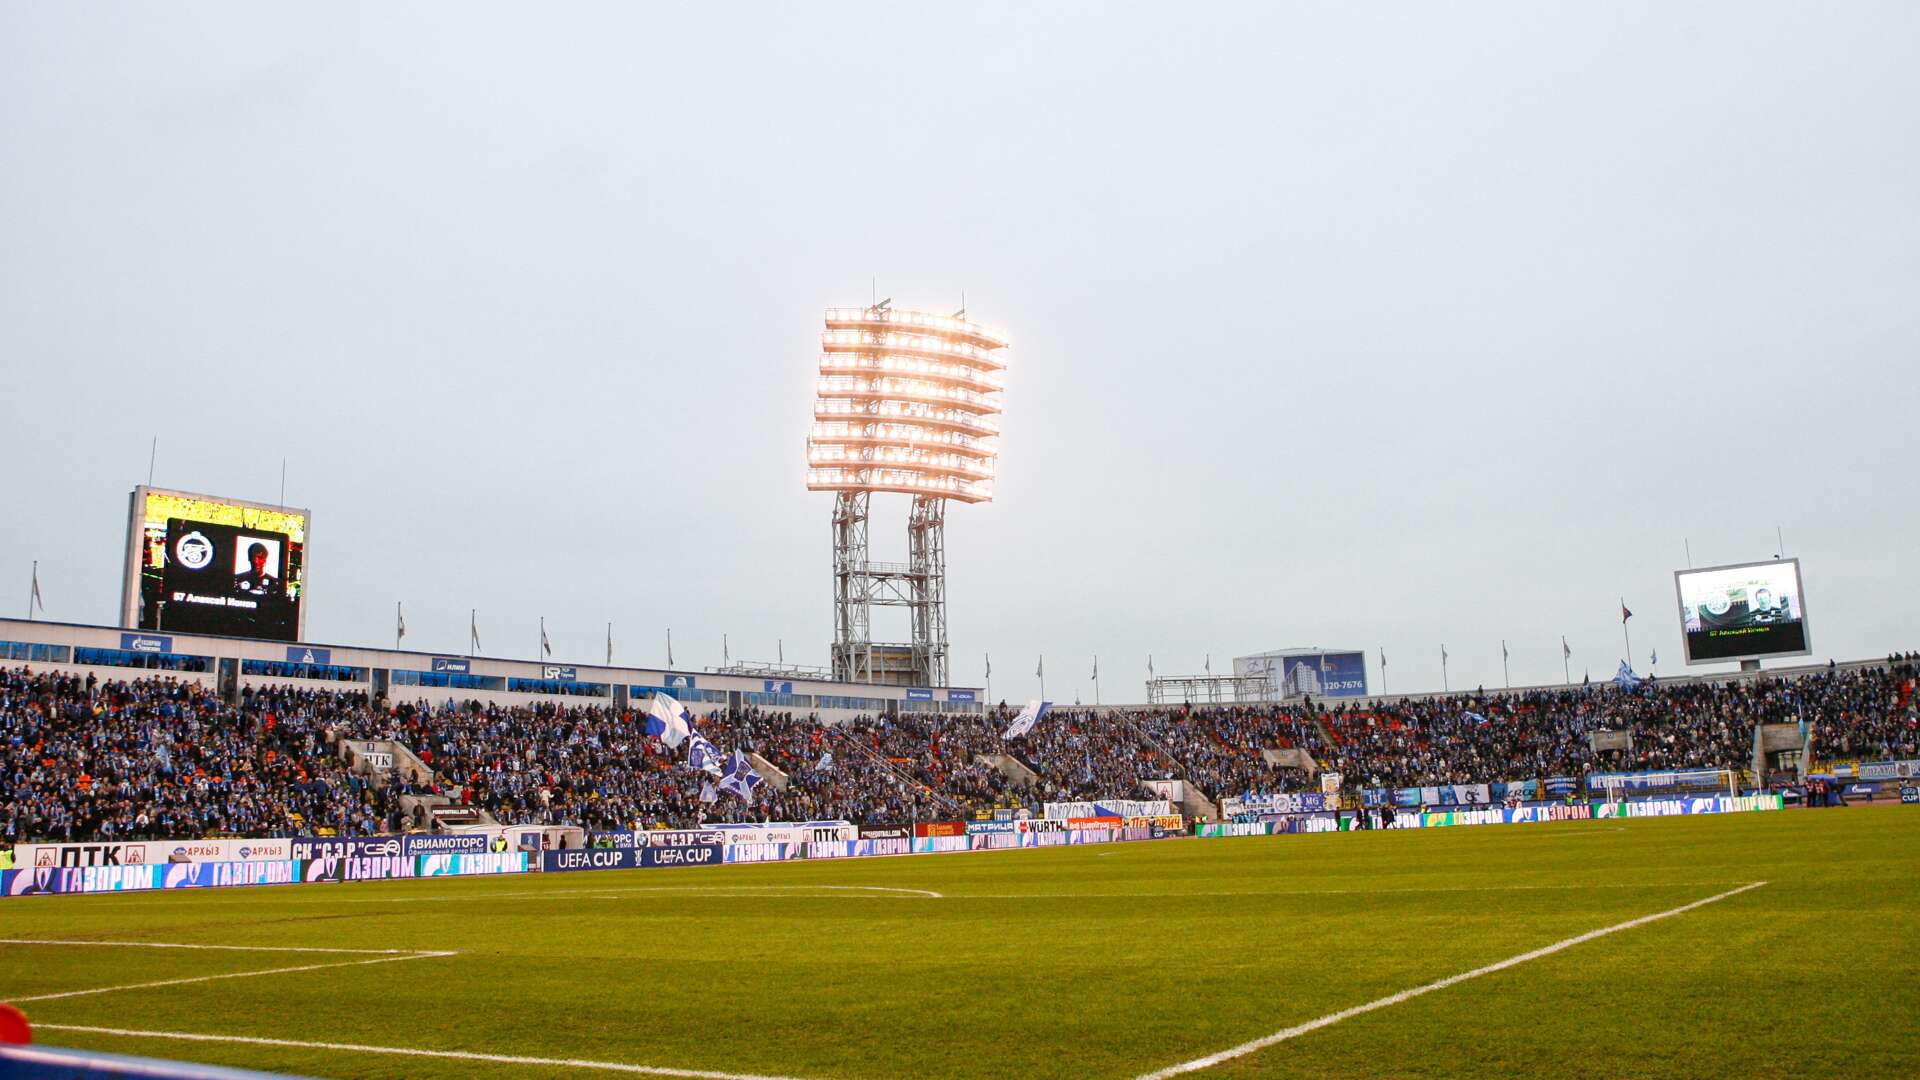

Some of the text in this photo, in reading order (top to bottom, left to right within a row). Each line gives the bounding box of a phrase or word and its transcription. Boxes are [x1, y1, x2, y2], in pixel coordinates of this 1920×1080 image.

[1625, 800, 1681, 817] ГАЗПРОМ
[1719, 792, 1779, 812] ГАЗПРОМ
[1454, 809, 1503, 826] ГАЗПРОМ
[1537, 805, 1590, 822] ГАЗПРОМ
[813, 828, 839, 842] ПТК
[967, 822, 1014, 832] МАТРИЦА
[1028, 820, 1063, 833] WÜRTH
[252, 846, 282, 856] АРХЫЗ
[292, 842, 312, 860] СК
[409, 836, 484, 849] АВИАМОТОРС
[808, 841, 848, 858] ГАЗПРОМ
[61, 845, 121, 868] ПТК
[187, 846, 220, 857] АРХЫЗ
[558, 851, 623, 868] UEFA CUP
[654, 848, 712, 864] UEFA CUP
[734, 843, 779, 861] ГАЗПРОМ
[344, 855, 416, 880] ГАЗПРОМ
[460, 851, 522, 875] ГАЗПРОМ
[60, 864, 154, 892] ГАЗПРОМ
[212, 860, 292, 887] ГАЗПРОМ
